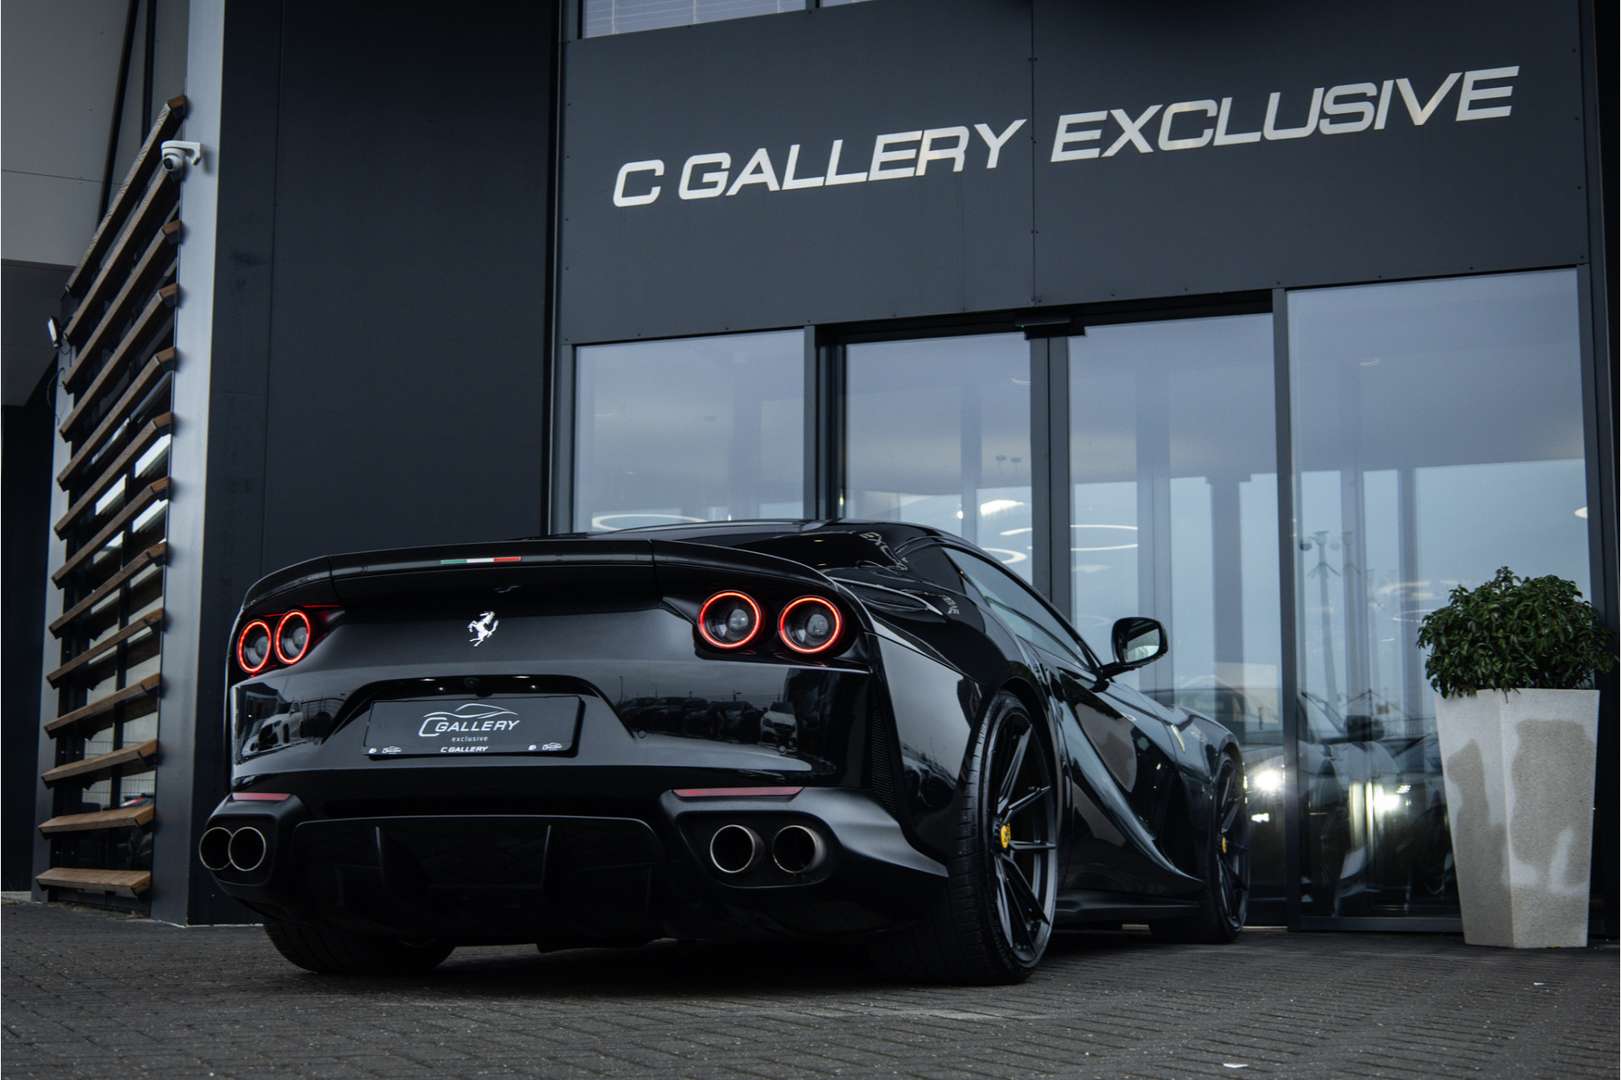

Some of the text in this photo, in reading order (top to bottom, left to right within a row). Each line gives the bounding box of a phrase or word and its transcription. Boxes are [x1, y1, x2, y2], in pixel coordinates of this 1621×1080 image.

[612, 65, 1520, 208] C GALLERY EXCLUSIVE
[448, 745, 488, 753] GALLERY
